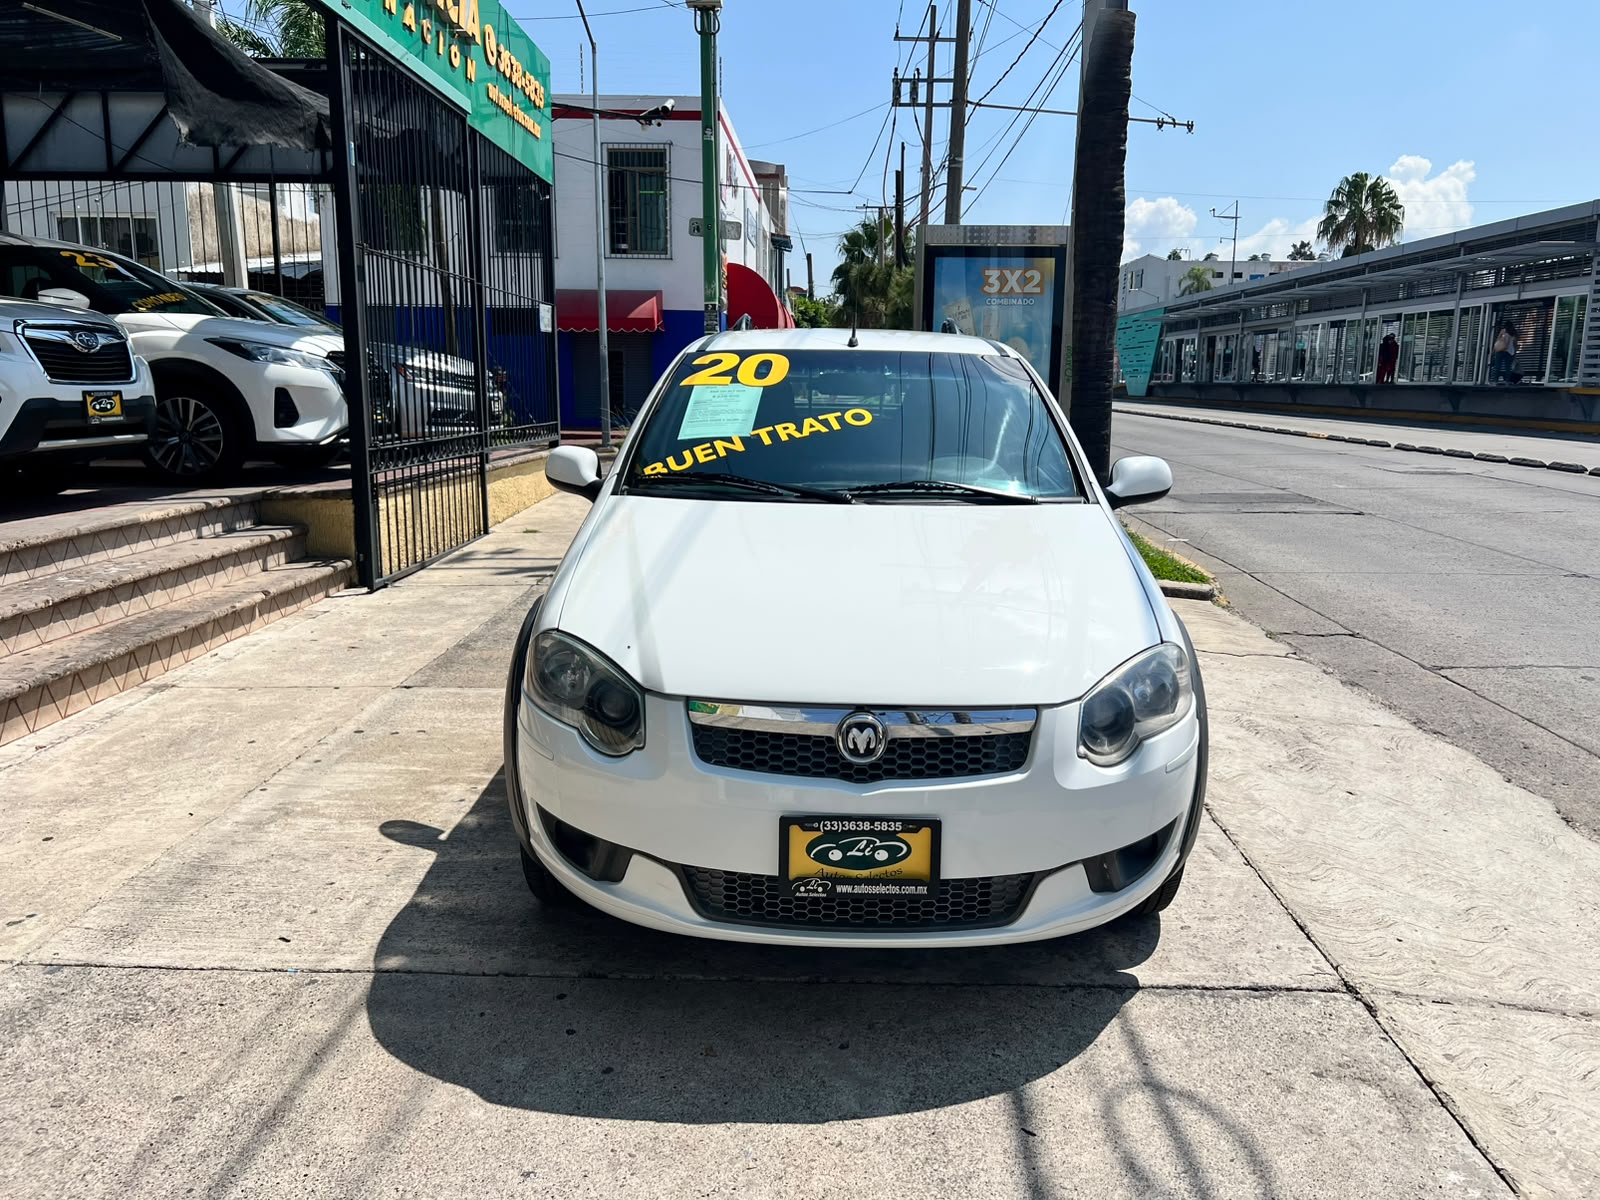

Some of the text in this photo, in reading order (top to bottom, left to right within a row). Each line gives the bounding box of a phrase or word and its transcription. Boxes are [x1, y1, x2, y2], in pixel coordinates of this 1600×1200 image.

[498, 43, 545, 109] 3638-5835
[983, 269, 1041, 293] 3X2
[679, 352, 790, 387] 20
[643, 435, 746, 478] BUEN
[750, 408, 873, 446] TRATO
[820, 821, 902, 832] (33)3638-5835
[814, 867, 850, 879] Auto
[836, 883, 928, 895] www.autosselectos.com.mx
